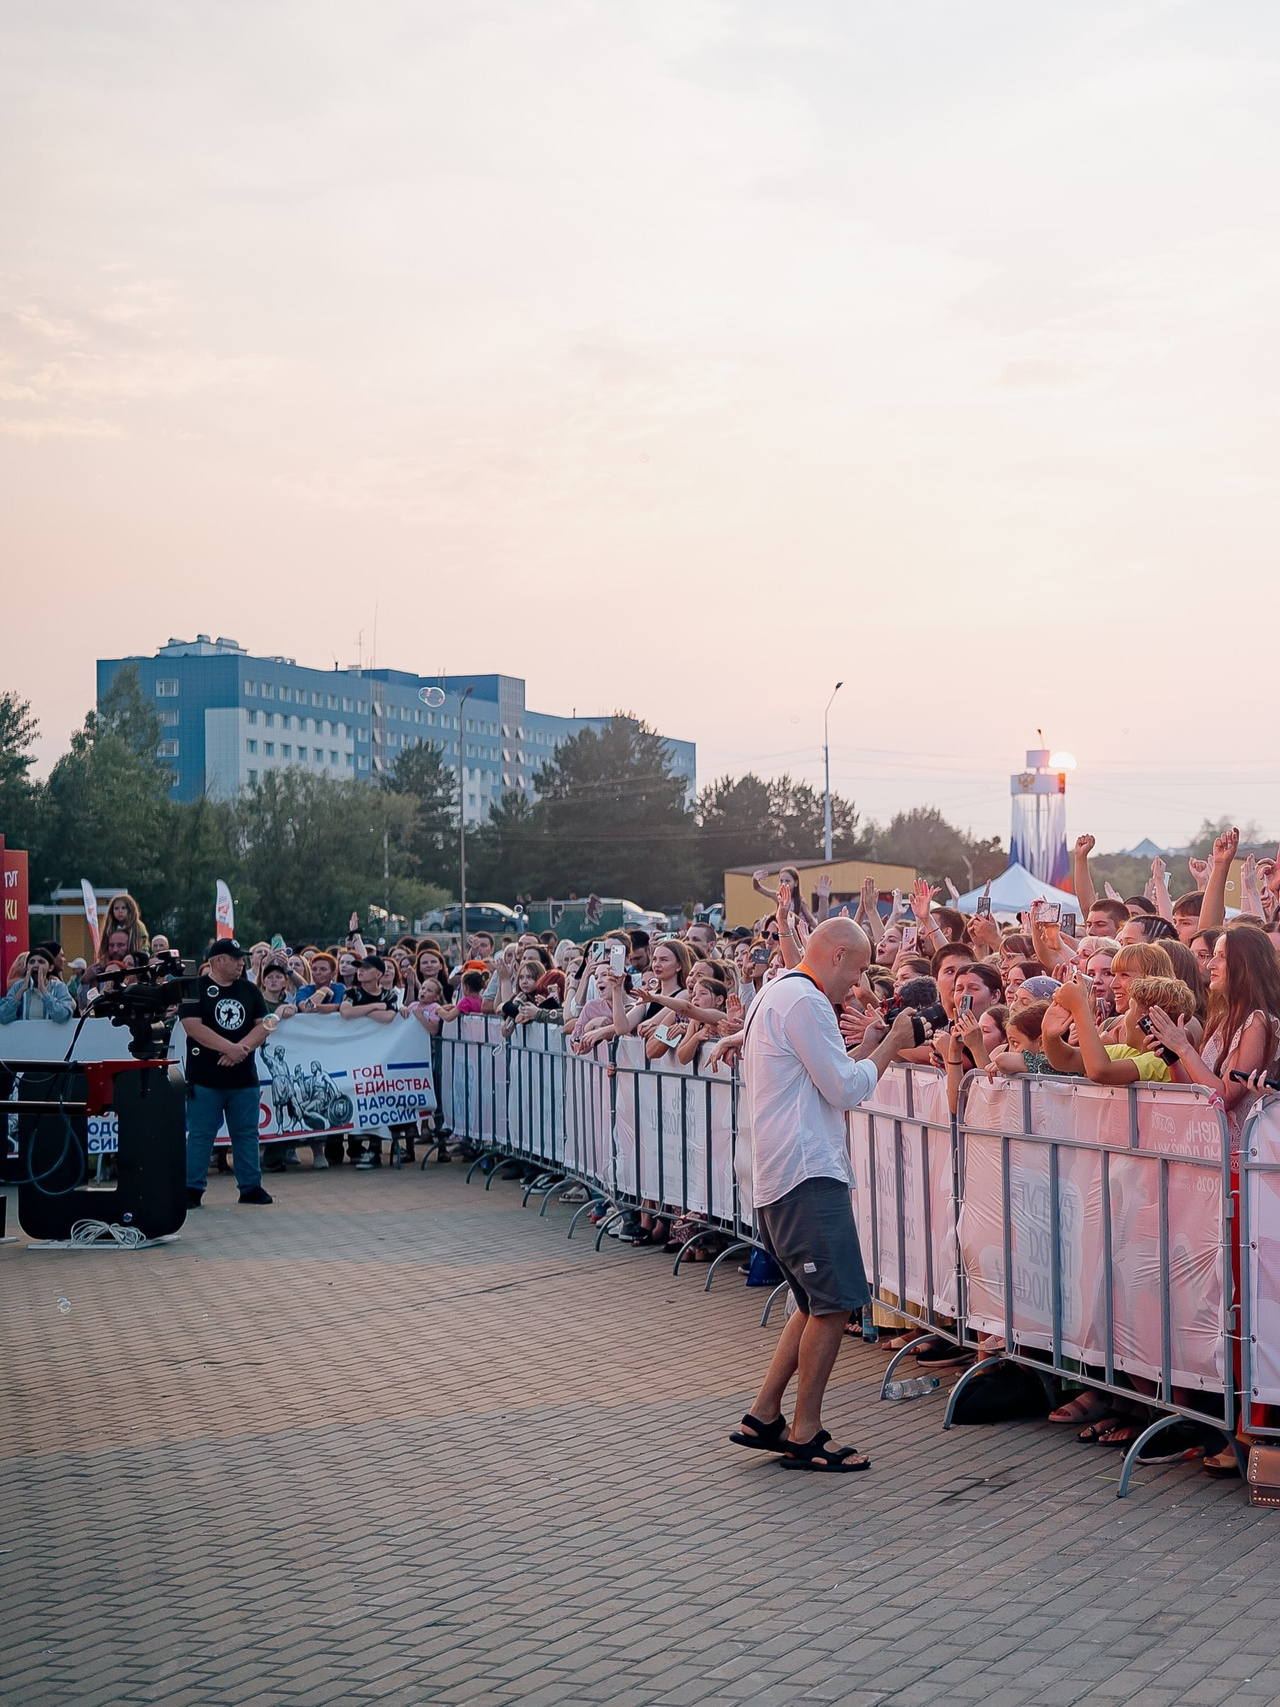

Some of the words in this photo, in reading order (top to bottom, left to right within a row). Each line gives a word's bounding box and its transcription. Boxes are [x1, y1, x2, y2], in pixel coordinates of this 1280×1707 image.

[352, 1064, 384, 1080] ГОД
[354, 1078, 432, 1096] ЕДИНСТВА
[356, 1093, 427, 1112] НАРОДОВ
[358, 1108, 416, 1128] РОССИИ
